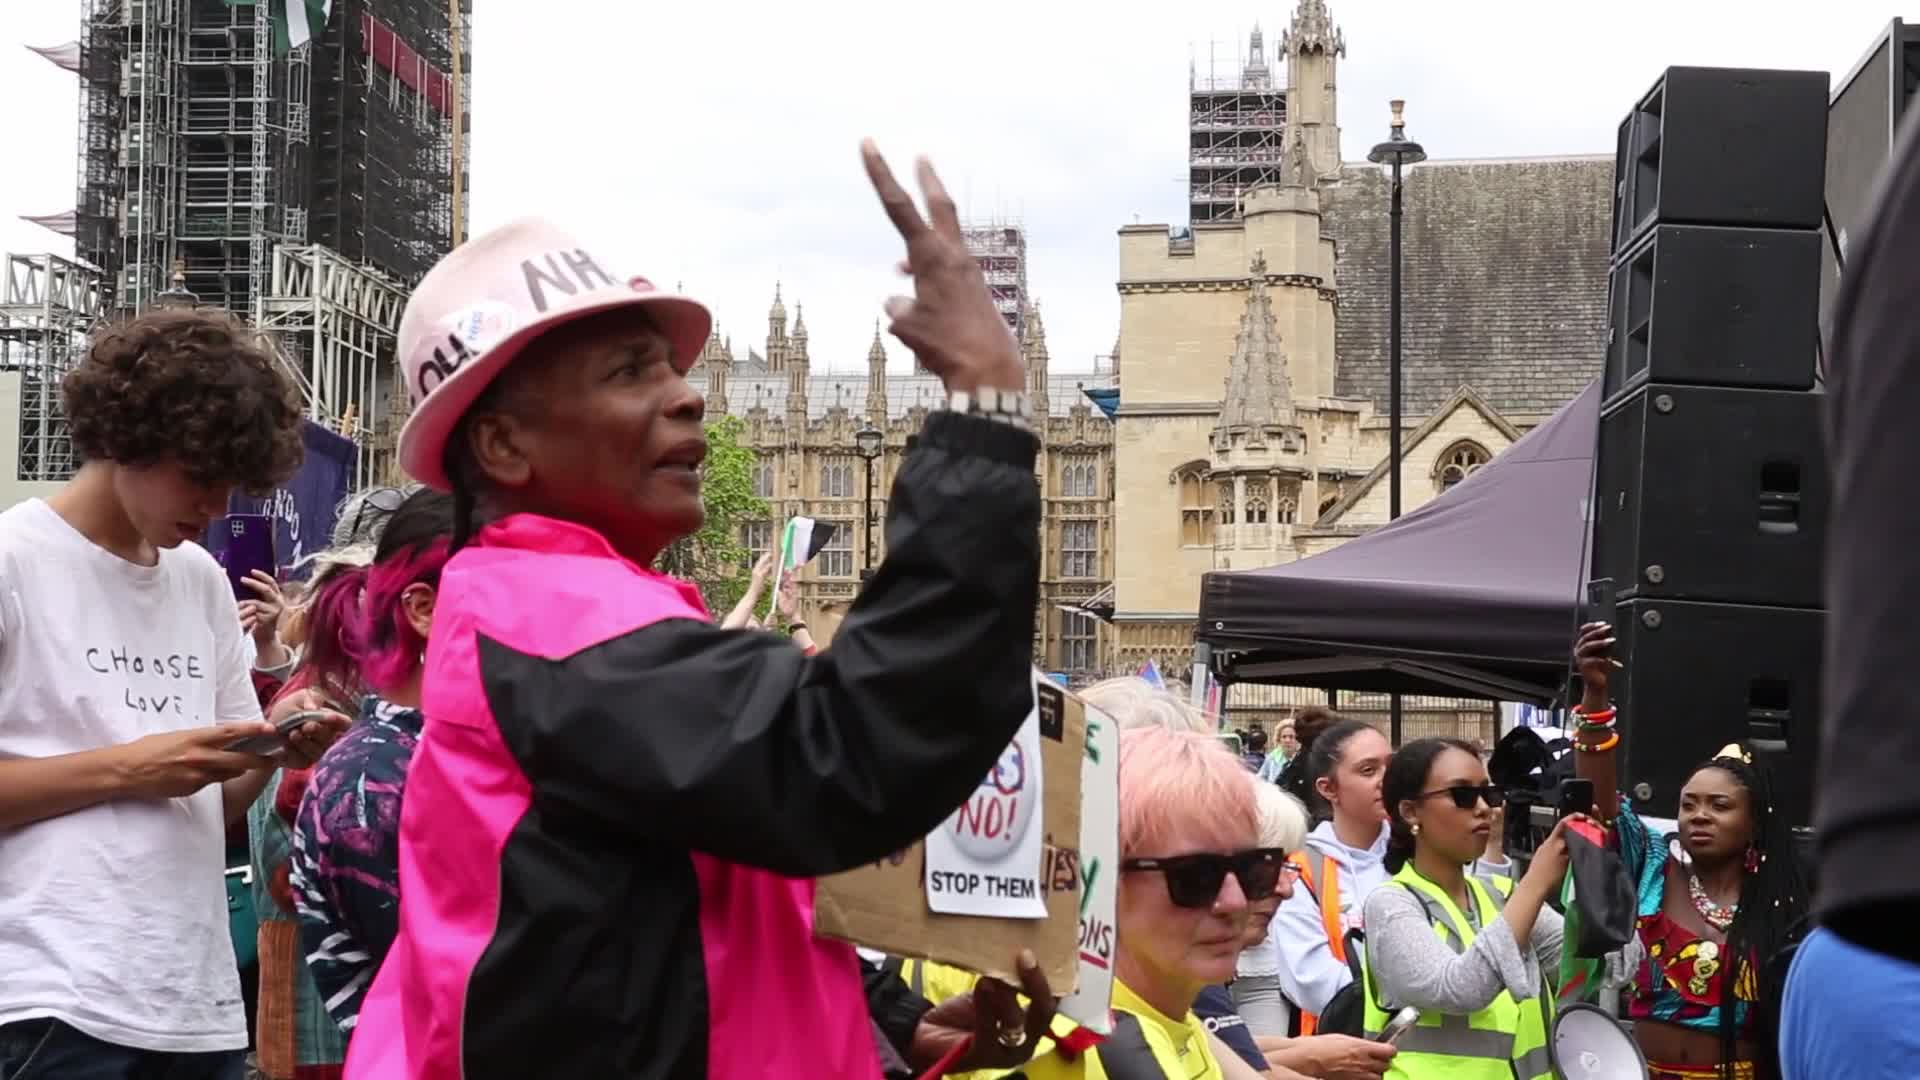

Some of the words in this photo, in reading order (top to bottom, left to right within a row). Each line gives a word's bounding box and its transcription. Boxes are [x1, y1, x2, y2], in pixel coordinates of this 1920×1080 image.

[520, 248, 617, 313] NH
[86, 645, 205, 679] CHOOSE
[956, 795, 1017, 839] NO!
[931, 869, 980, 895] STOP
[984, 875, 1036, 899] THEM
[1079, 916, 1112, 959] ONS
